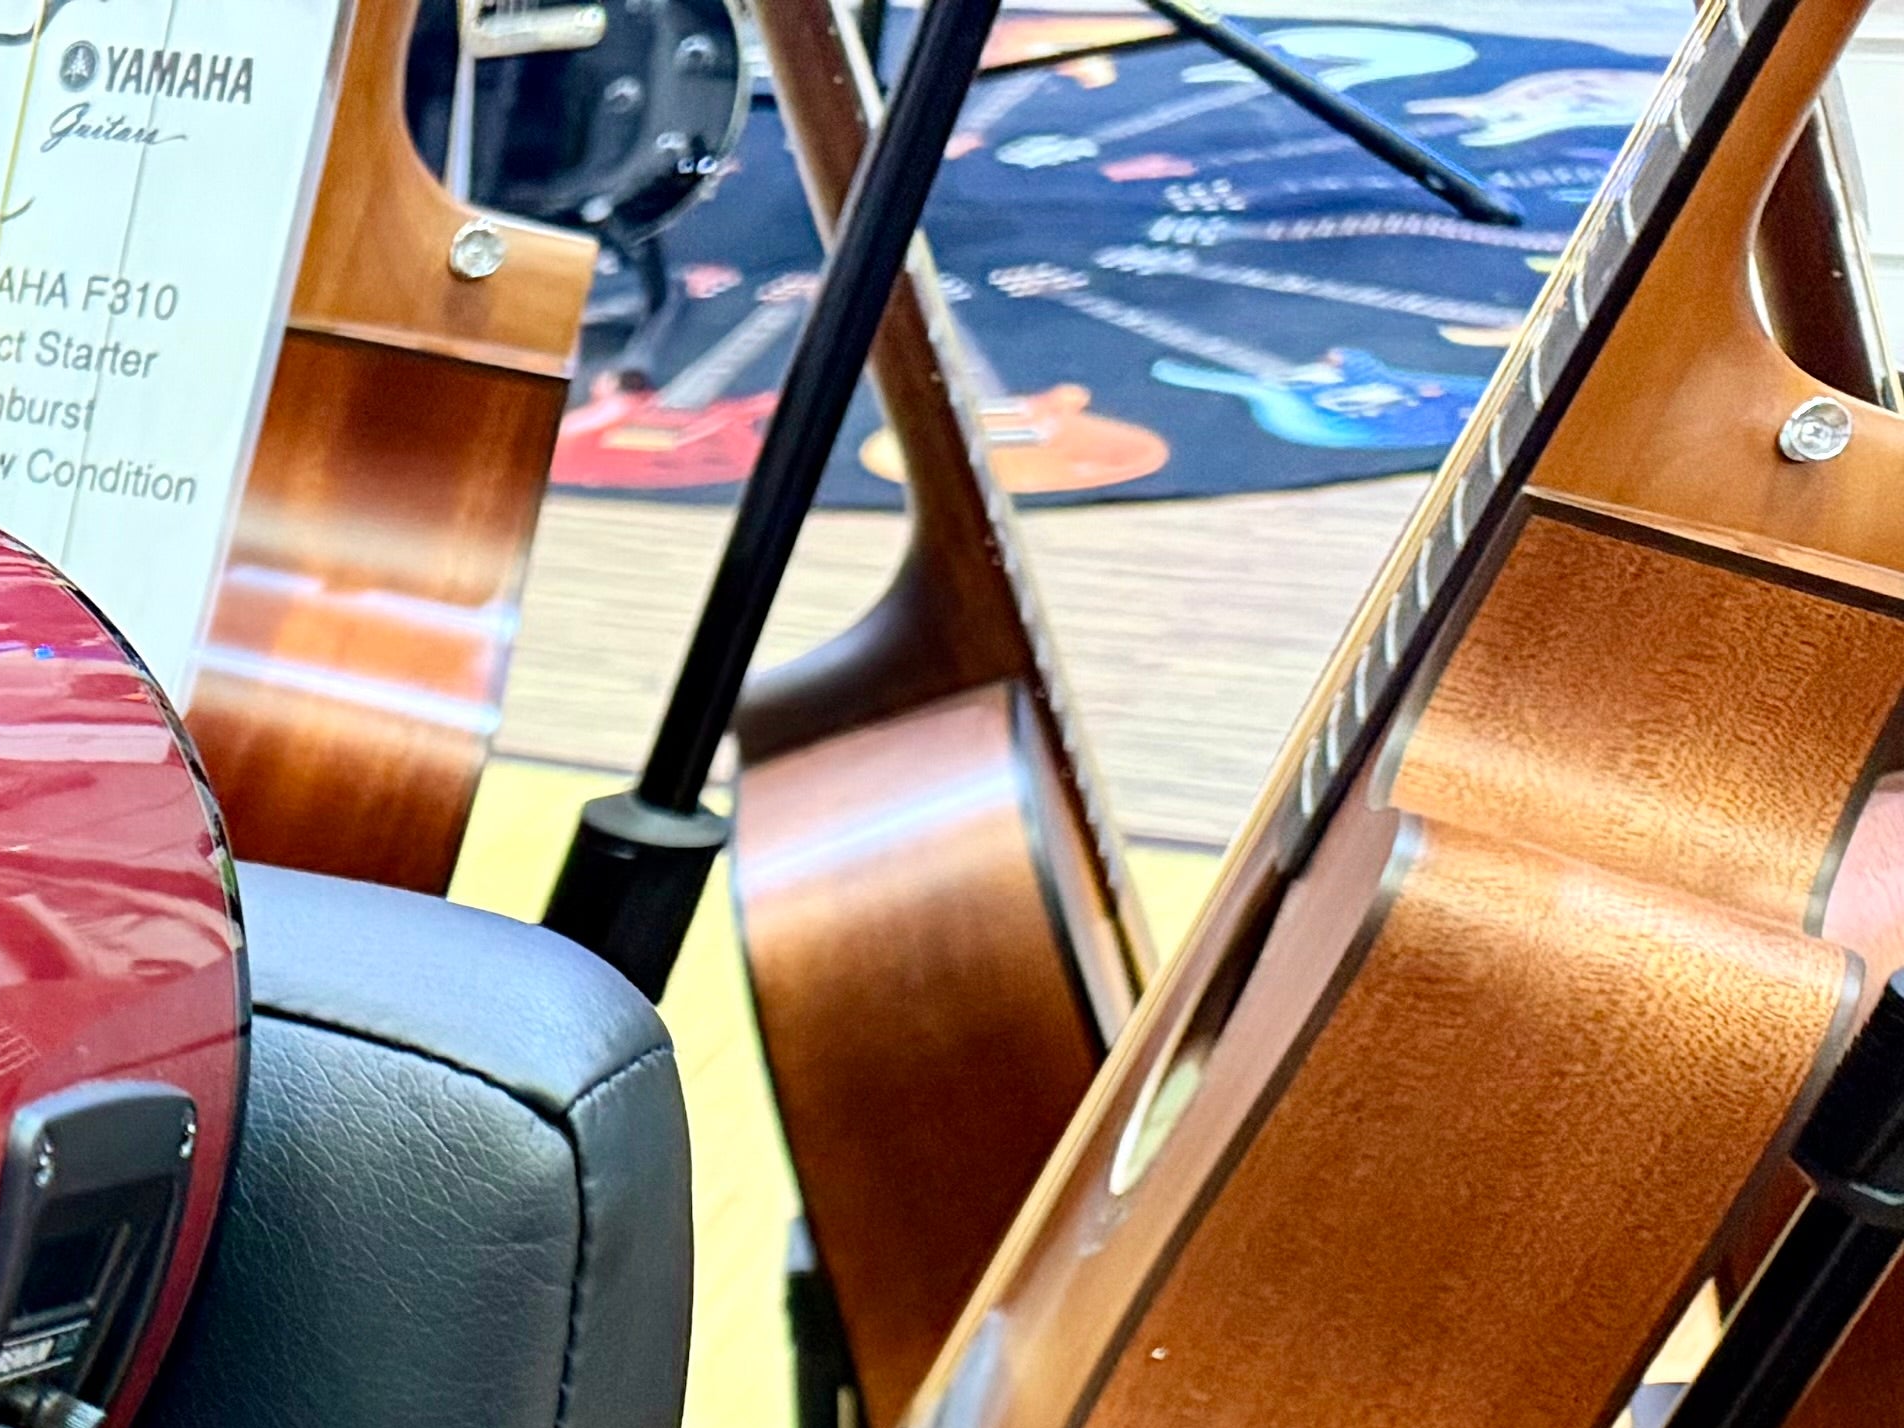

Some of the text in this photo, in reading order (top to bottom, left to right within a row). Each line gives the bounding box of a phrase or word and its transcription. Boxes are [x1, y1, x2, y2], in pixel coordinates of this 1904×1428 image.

[105, 46, 253, 104] YAMAHA
[82, 276, 178, 320] F310
[36, 330, 159, 378] Starter
[27, 447, 198, 504] Condition
